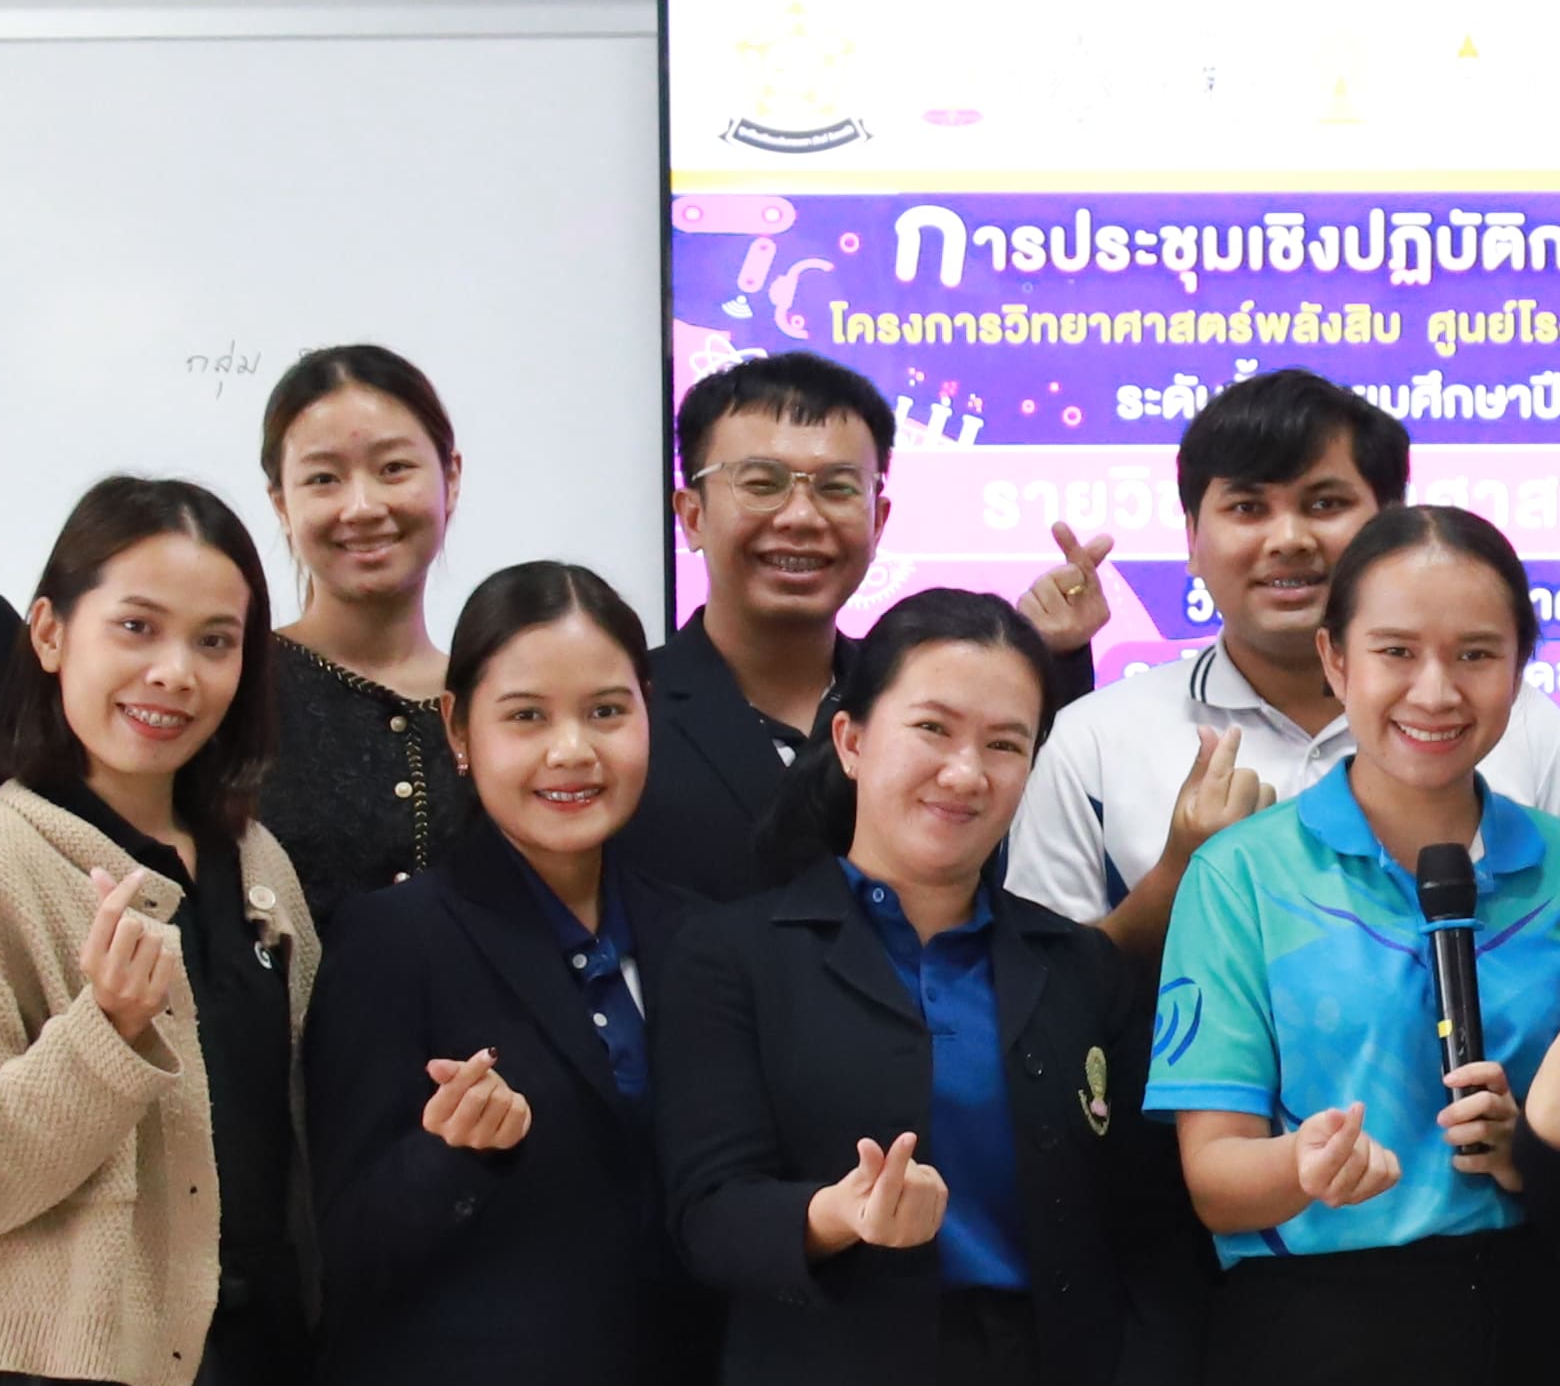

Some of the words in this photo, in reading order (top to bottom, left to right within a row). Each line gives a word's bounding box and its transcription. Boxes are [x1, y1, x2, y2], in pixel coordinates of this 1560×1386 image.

[829, 300, 1401, 345] โครงการวิทยาศาสตร์พลังสิบ
